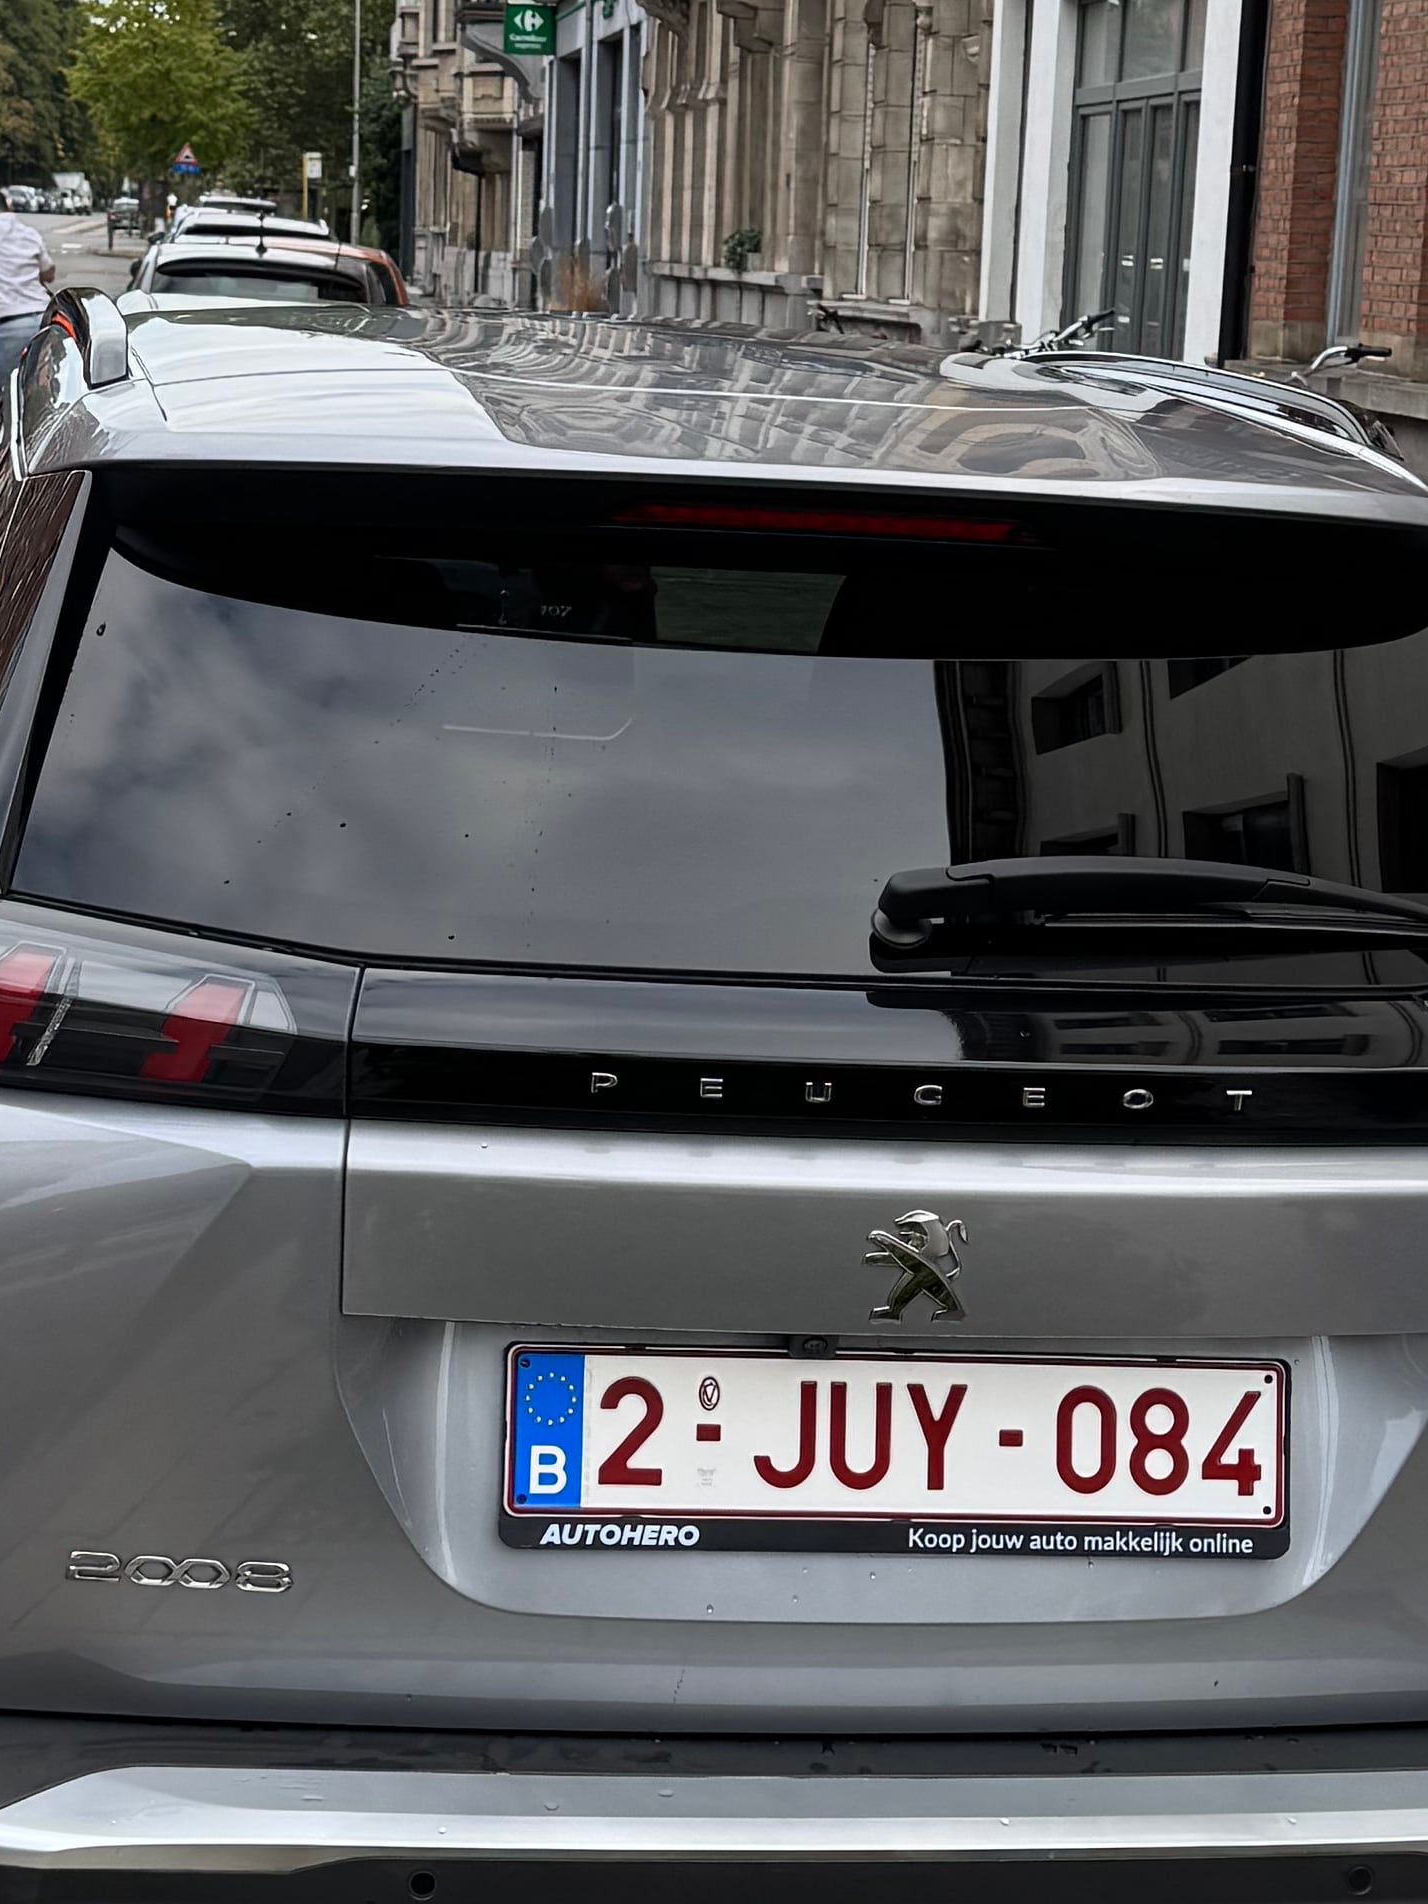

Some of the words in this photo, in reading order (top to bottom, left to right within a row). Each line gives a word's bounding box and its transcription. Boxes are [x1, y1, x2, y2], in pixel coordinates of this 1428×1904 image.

[590, 1072, 1253, 1110] PEUGEOT
[529, 1444, 567, 1495] B
[540, 1523, 701, 1547] AUTOHERO
[908, 1527, 966, 1552] Koop
[970, 1528, 1025, 1554] jouw
[1029, 1530, 1078, 1551] auto
[1083, 1531, 1183, 1557] makkelijk
[1189, 1533, 1254, 1554] online
[68, 1549, 294, 1593] 2008
